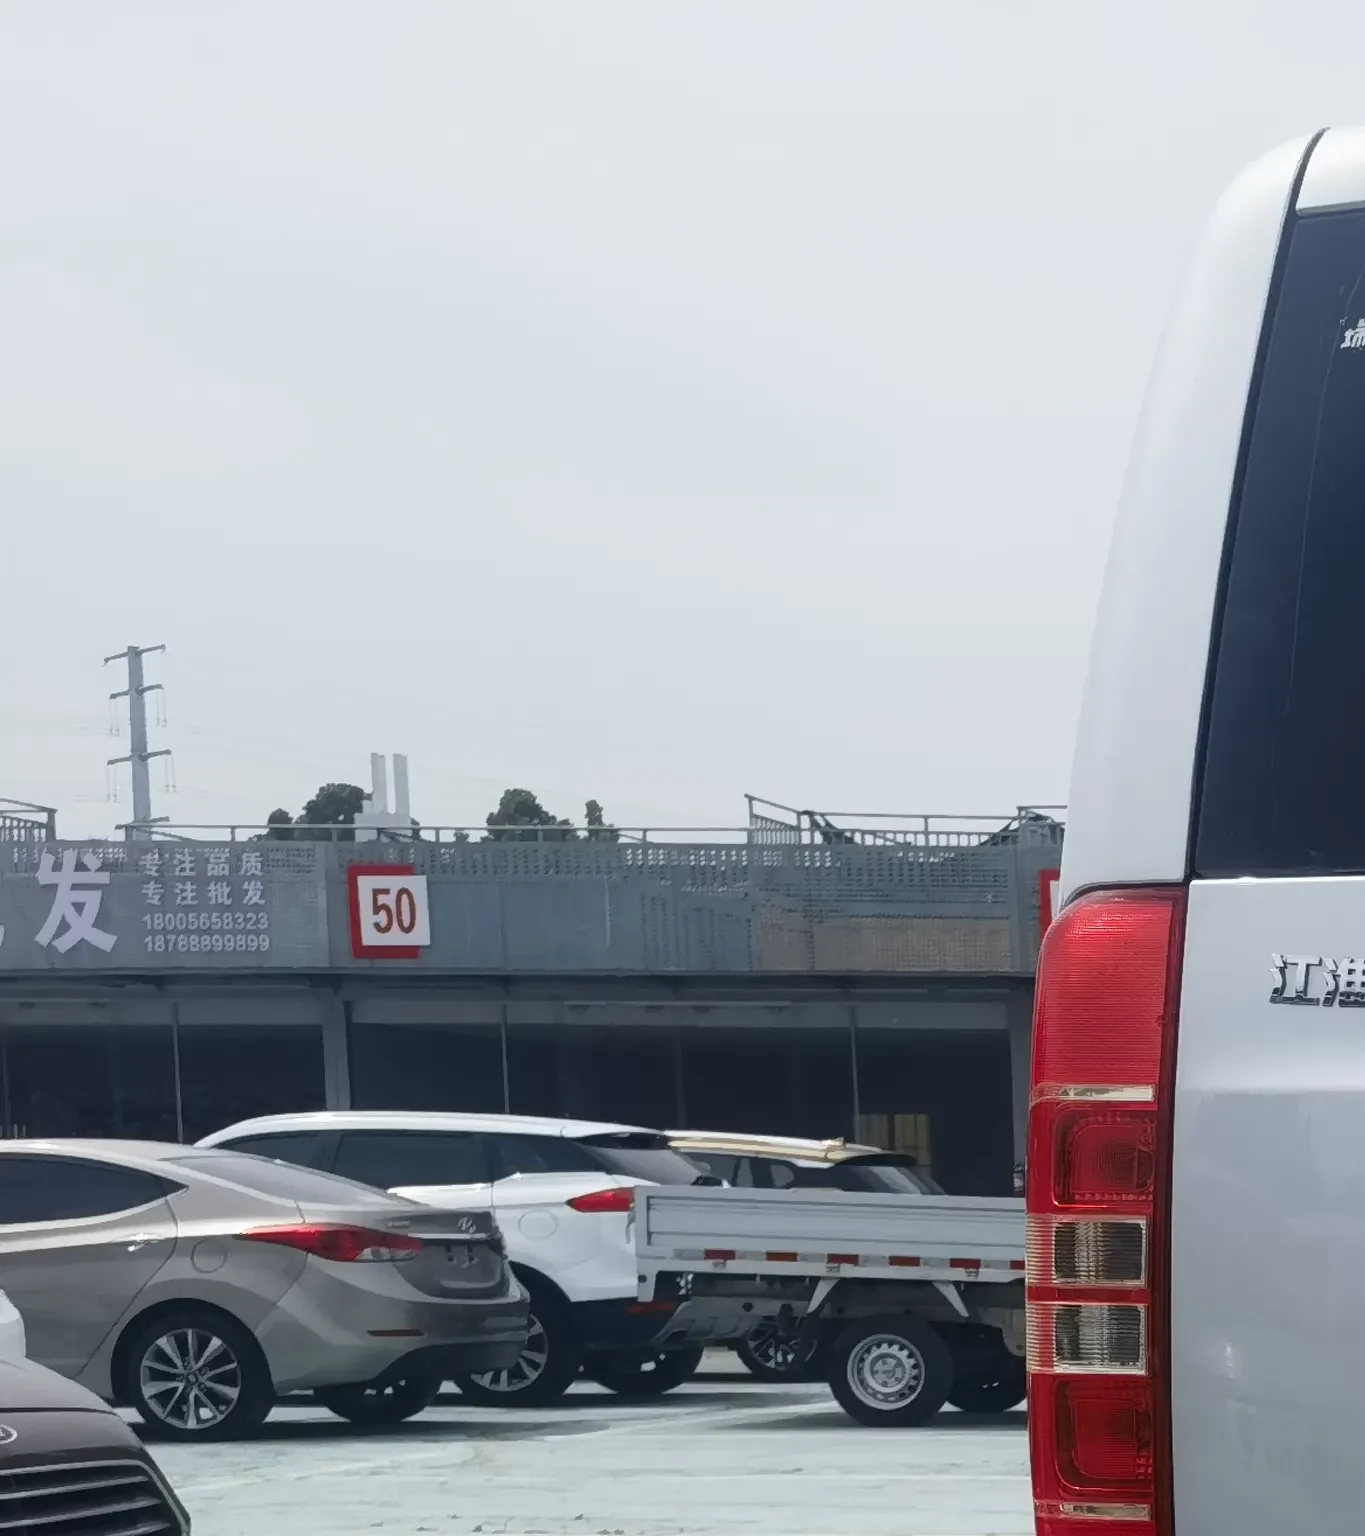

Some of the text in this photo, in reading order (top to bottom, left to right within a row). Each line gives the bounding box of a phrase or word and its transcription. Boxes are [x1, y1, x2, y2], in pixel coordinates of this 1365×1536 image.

[0, 847, 118, 954] 发
[141, 880, 265, 906] 专注批发
[371, 887, 417, 935] 50
